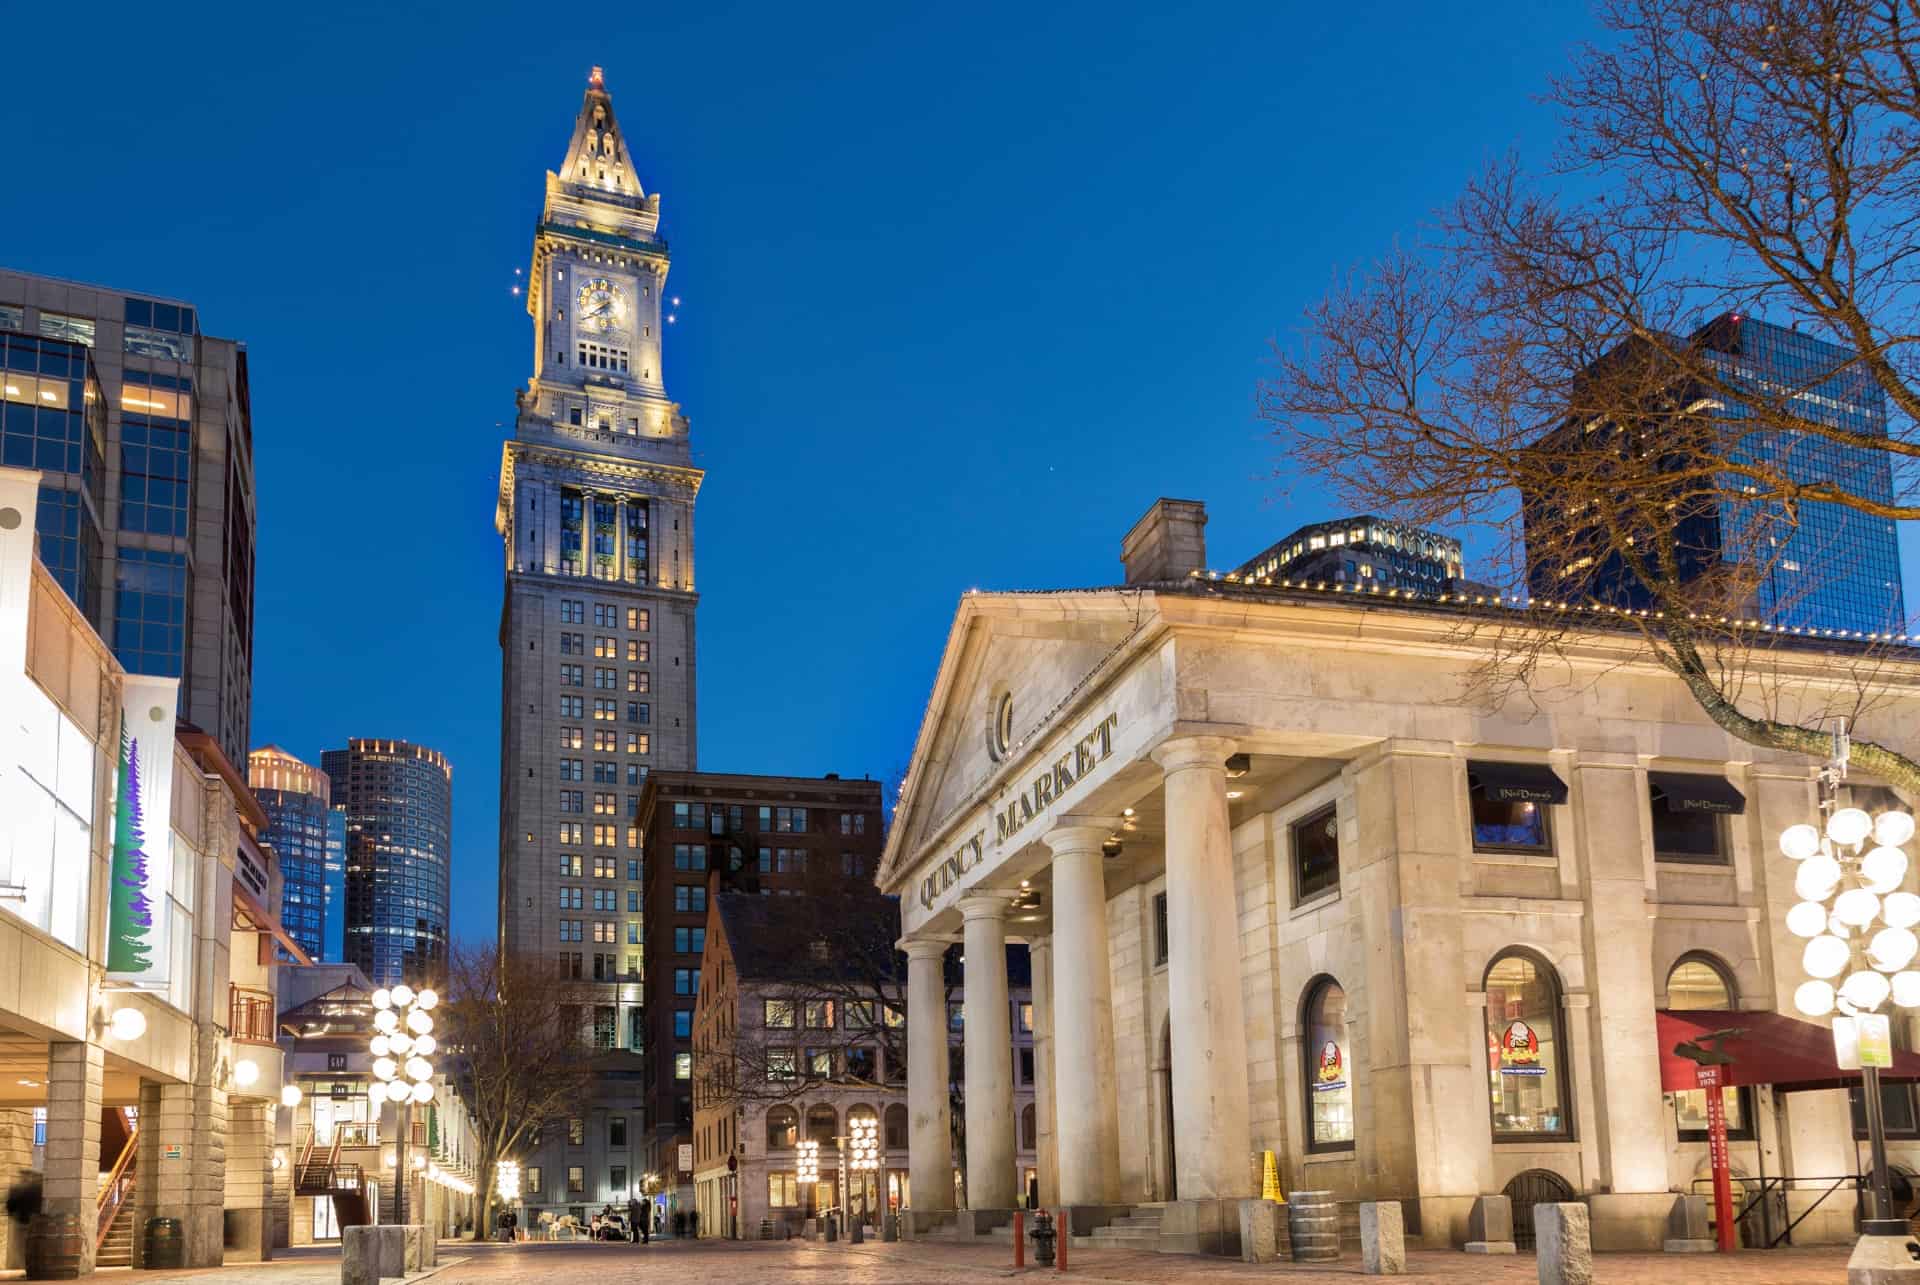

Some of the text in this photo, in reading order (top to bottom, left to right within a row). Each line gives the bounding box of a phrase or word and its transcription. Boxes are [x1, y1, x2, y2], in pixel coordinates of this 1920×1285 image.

[920, 711, 1118, 911] QUINCY MARKET
[331, 1056, 345, 1069] GAP
